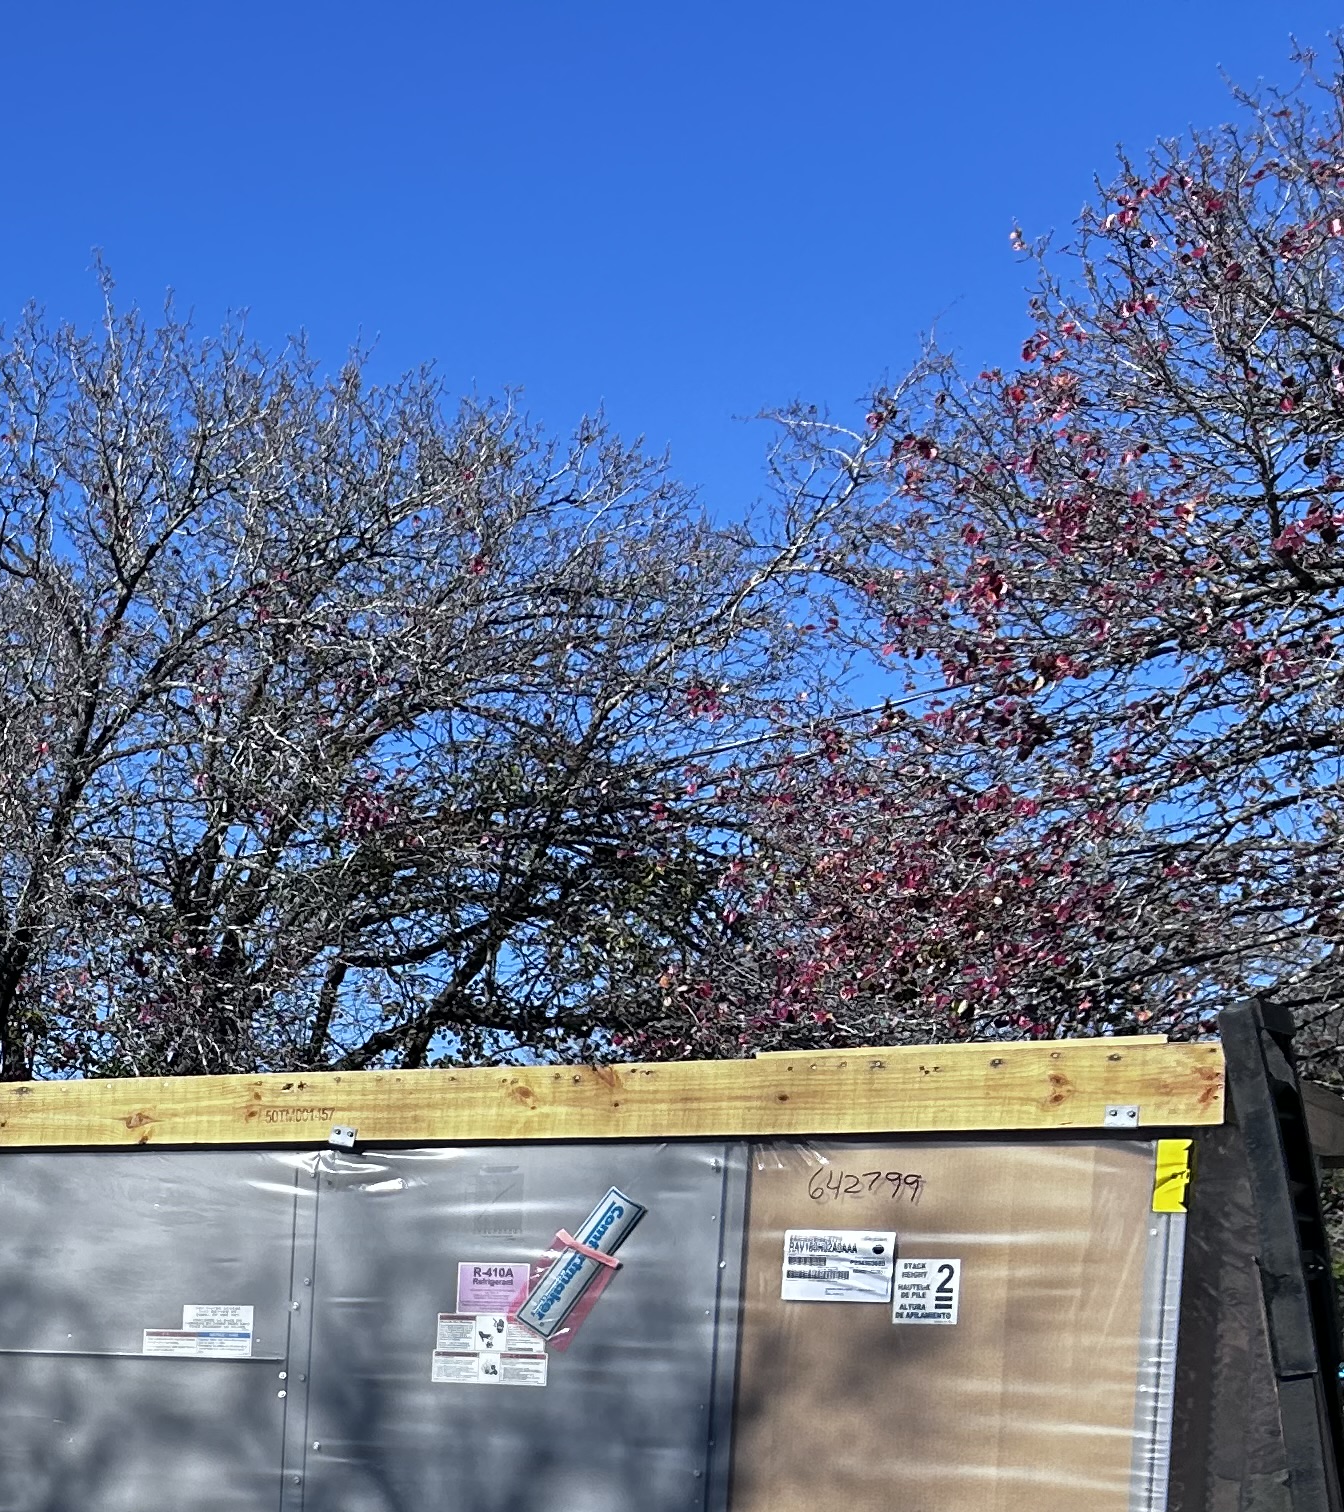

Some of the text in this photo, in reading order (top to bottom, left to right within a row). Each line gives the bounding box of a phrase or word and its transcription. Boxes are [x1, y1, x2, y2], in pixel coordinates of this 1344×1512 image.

[808, 1167, 922, 1201] 642799
[473, 1266, 514, 1278] R-410A
[537, 1205, 624, 1321] Comfrtmaker
[473, 1278, 513, 1287] Refrigerant
[936, 1264, 954, 1293] 2
